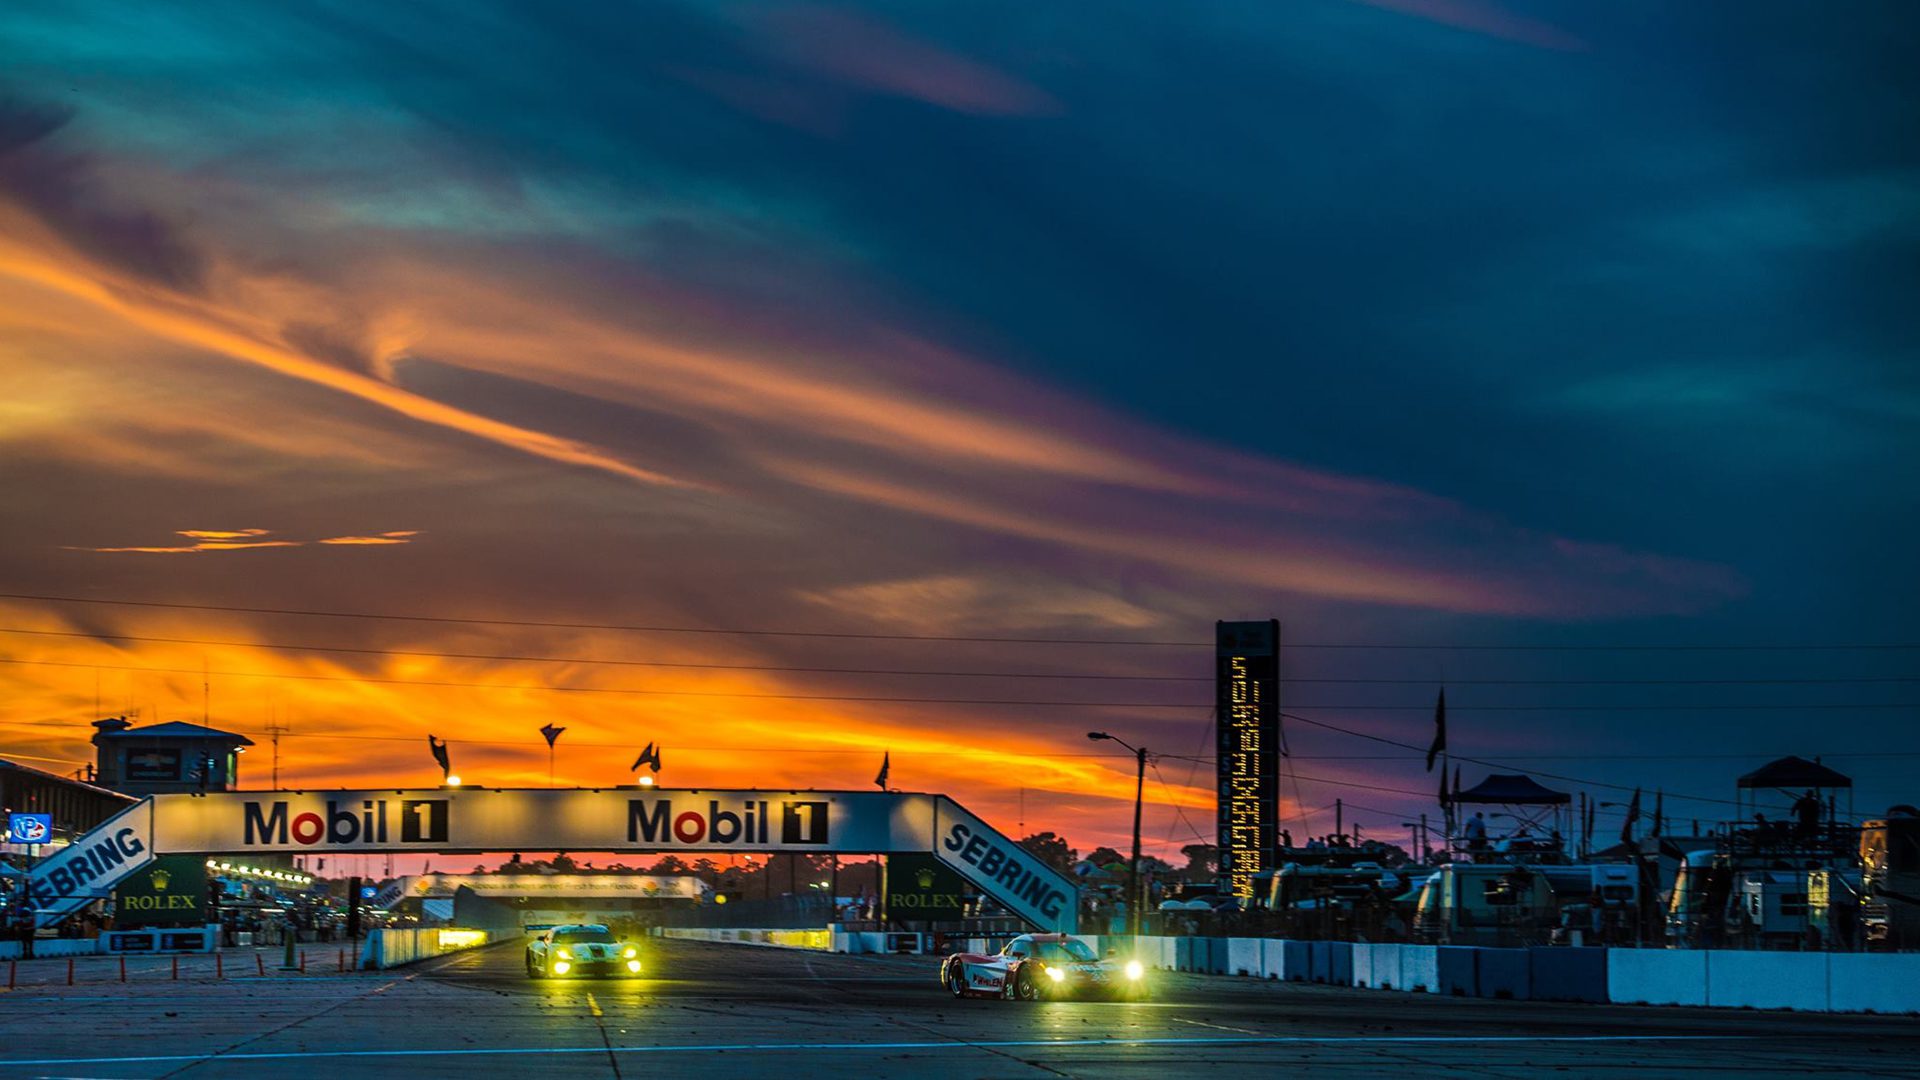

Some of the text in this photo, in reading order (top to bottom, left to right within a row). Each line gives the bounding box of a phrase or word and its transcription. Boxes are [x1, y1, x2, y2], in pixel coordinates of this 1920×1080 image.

[1232, 656, 1246, 679] 5
[1232, 681, 1260, 704] 01
[1240, 729, 1260, 752] 10
[1232, 753, 1260, 776] 31
[1222, 781, 1230, 796] 6
[244, 800, 388, 845] Mobil
[627, 800, 769, 844] Mobil
[1222, 805, 1230, 820] 7
[1222, 829, 1230, 844] 8
[31, 828, 145, 908] EBRING
[944, 823, 1068, 920] SEBRING
[1222, 853, 1230, 869] 9
[1218, 878, 1232, 894] 10
[124, 895, 196, 910] ROLEX
[891, 894, 960, 909] ROLEX
